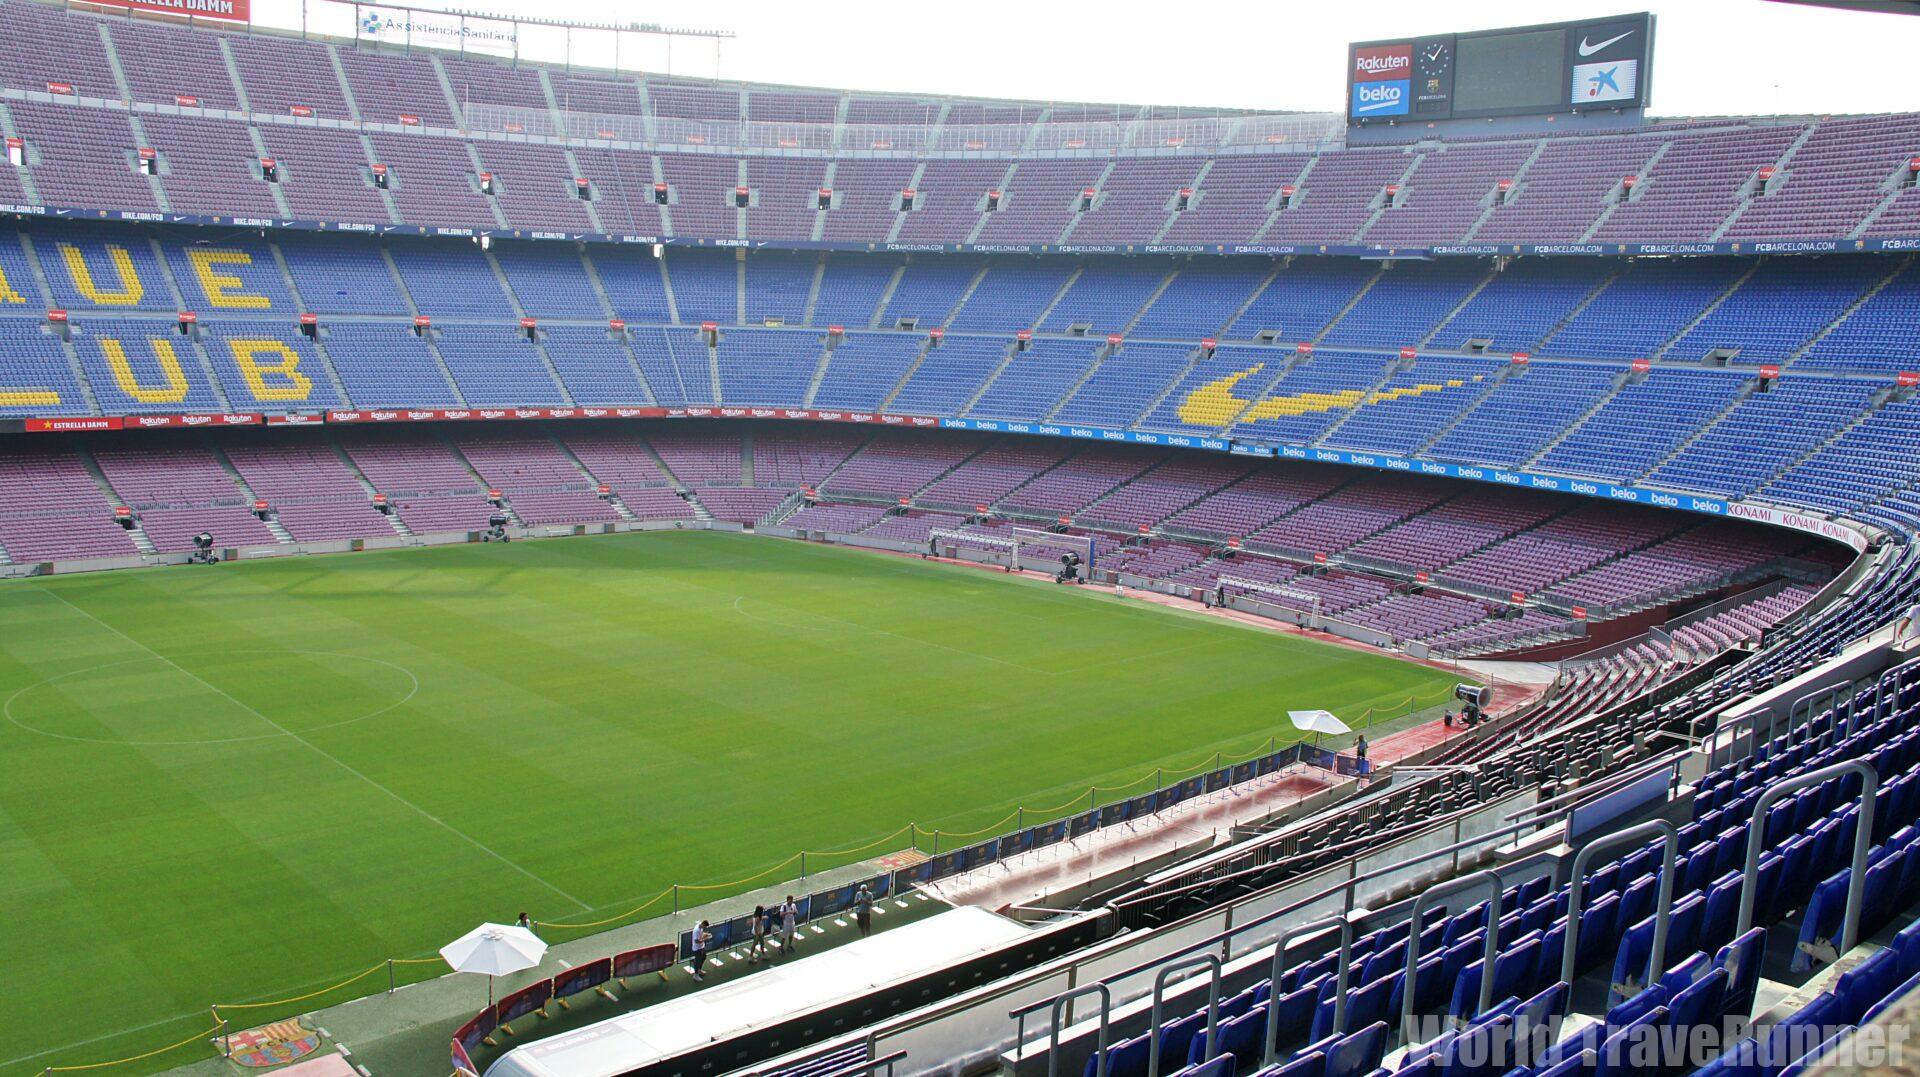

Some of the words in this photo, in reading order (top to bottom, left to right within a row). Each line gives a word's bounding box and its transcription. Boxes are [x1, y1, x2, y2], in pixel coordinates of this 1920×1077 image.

[186, 0, 232, 14] DAMM
[1357, 56, 1408, 70] Rakuten
[1359, 86, 1401, 101] beko
[333, 412, 360, 421] Rakuten
[371, 412, 397, 420] Rakuten
[408, 411, 433, 419] Rakuten
[445, 410, 470, 418] Rakuten
[480, 410, 505, 418] Rakuten
[516, 410, 540, 418] Rakuten
[550, 409, 574, 417] Rakuten
[752, 409, 775, 417] Rakuten
[819, 412, 841, 420] Rakuten
[140, 417, 169, 426] Rakuten
[182, 416, 211, 425] Rakuten
[224, 414, 252, 424] Rakuten
[882, 415, 904, 423] Rakuten
[946, 419, 966, 428] beko
[977, 421, 997, 430] beko
[1008, 424, 1028, 432] beko
[1040, 426, 1060, 434] beko
[1072, 428, 1092, 437] beko
[1104, 430, 1124, 440] beko
[1136, 433, 1157, 442] beko
[1168, 436, 1190, 445] beko
[1201, 439, 1222, 449] beko
[1284, 447, 1305, 457] beko
[1317, 451, 1340, 461] beko
[1352, 455, 1374, 465] beko
[1386, 459, 1410, 469] beko
[1422, 463, 1445, 474] beko
[1458, 467, 1482, 478] beko
[1495, 472, 1519, 483] beko
[1533, 477, 1558, 488] beko
[1571, 482, 1596, 494] beko
[1611, 487, 1637, 500] beko
[1651, 492, 1678, 507] beko
[1692, 499, 1720, 513] beko
[1728, 504, 1770, 521] KONAMI
[1782, 514, 1820, 530] KONAMI
[1823, 523, 1849, 541] KONAMI
